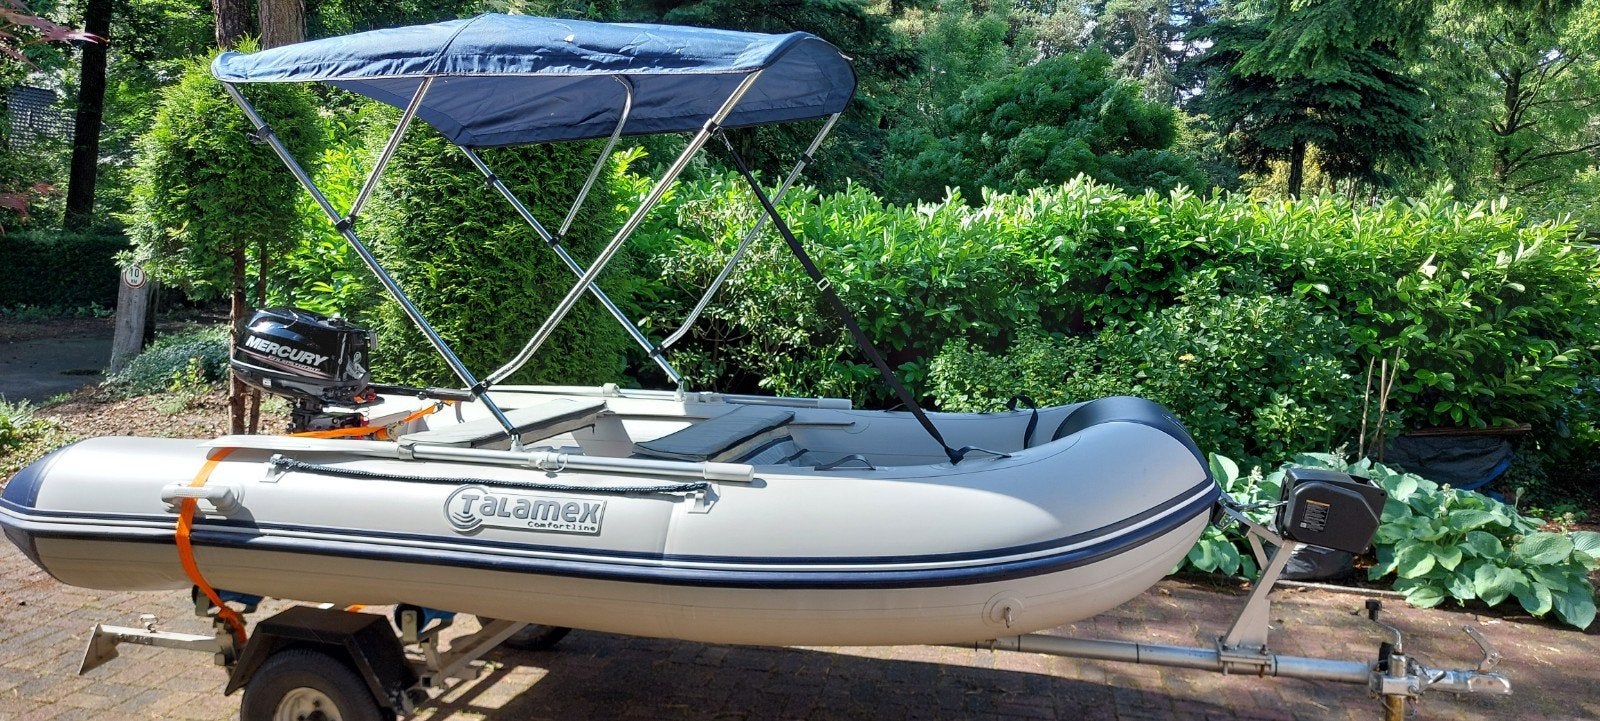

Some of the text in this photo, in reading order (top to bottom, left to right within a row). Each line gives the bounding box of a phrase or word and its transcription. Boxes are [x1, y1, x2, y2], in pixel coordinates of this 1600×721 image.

[130, 268, 140, 278] 10
[245, 335, 329, 366] MERCURY
[528, 521, 597, 532] Comfortline
